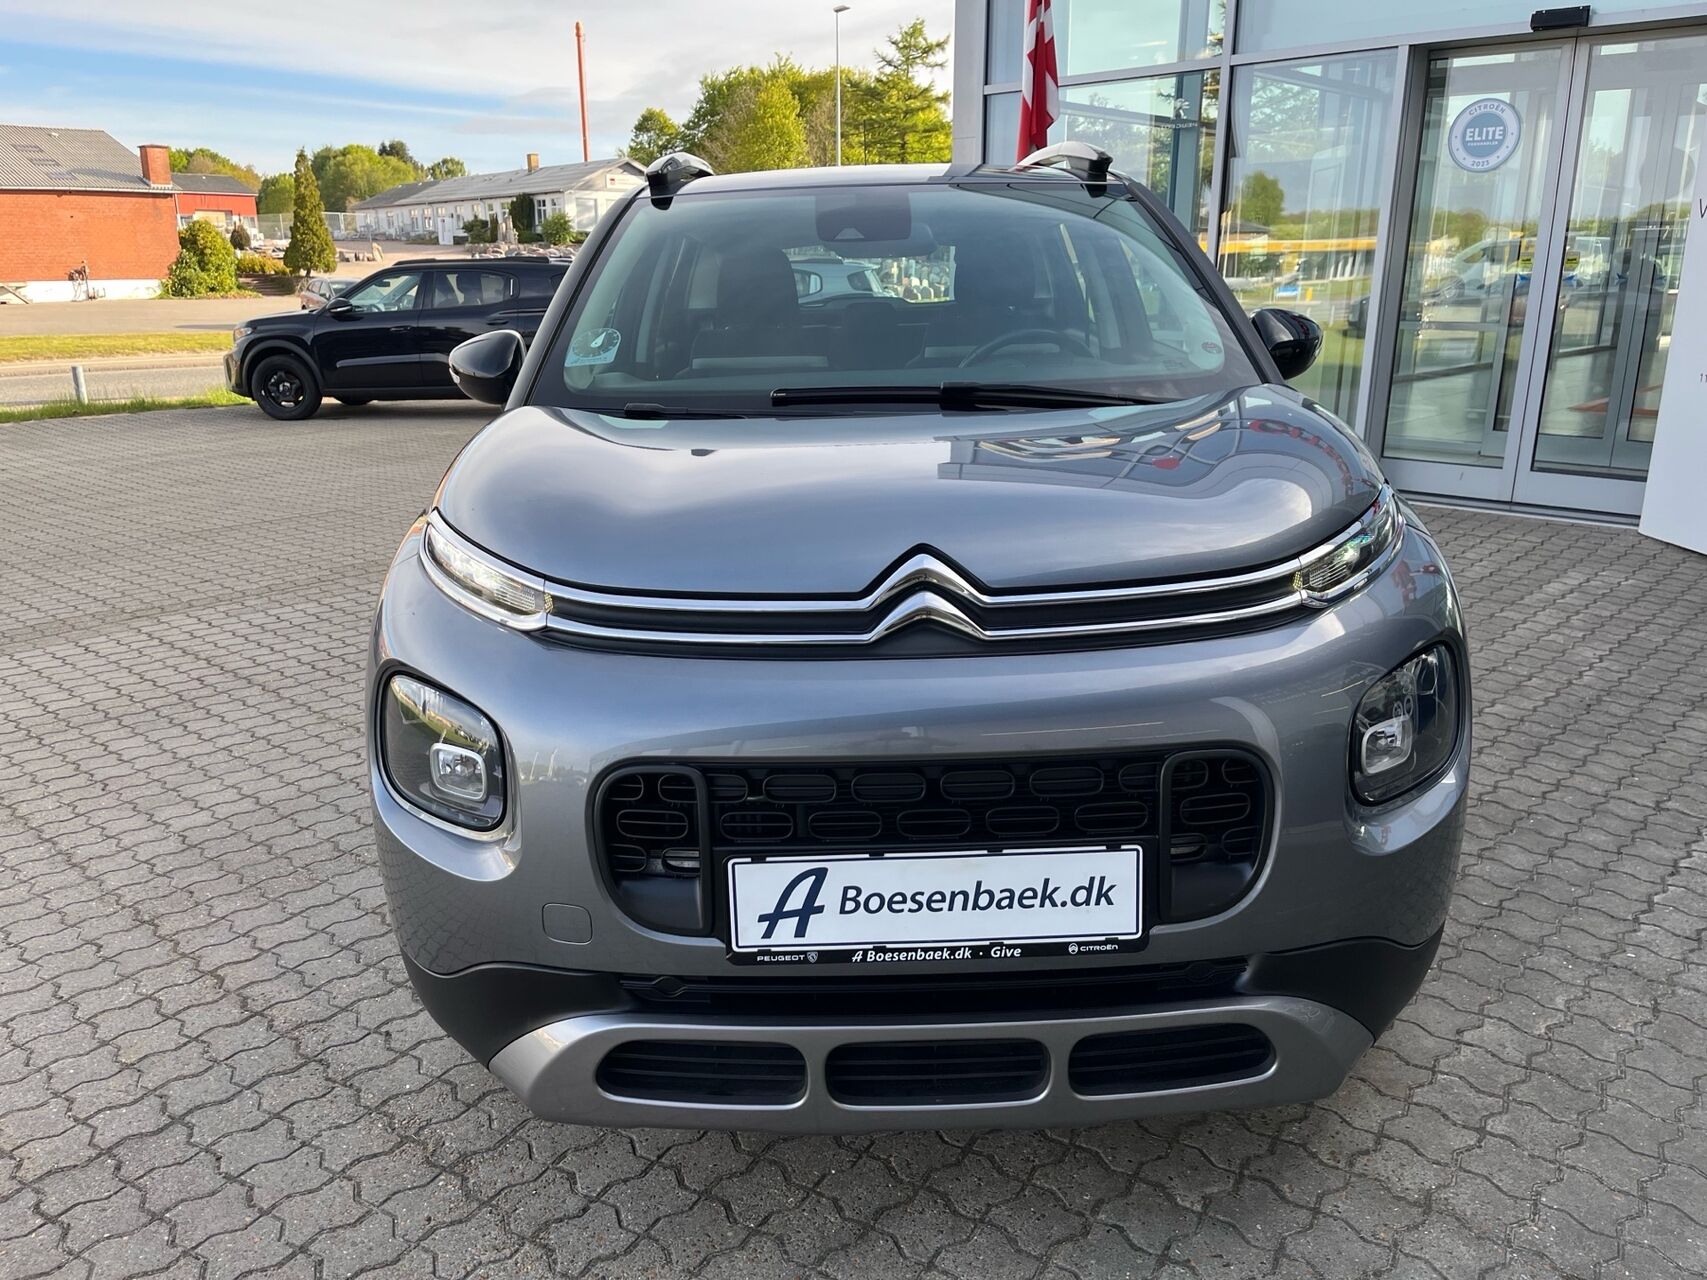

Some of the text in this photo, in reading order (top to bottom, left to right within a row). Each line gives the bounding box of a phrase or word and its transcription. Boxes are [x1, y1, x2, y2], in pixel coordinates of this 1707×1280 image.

[1468, 103, 1506, 116] CITROËN
[1465, 126, 1504, 141] ELITE
[839, 875, 1117, 915] Boesenbaek.dk
[866, 946, 972, 963] Boesenbaek.dk
[990, 945, 1022, 958] Give
[1080, 943, 1119, 952] CITROËN
[756, 954, 805, 962] PEUGEOT
